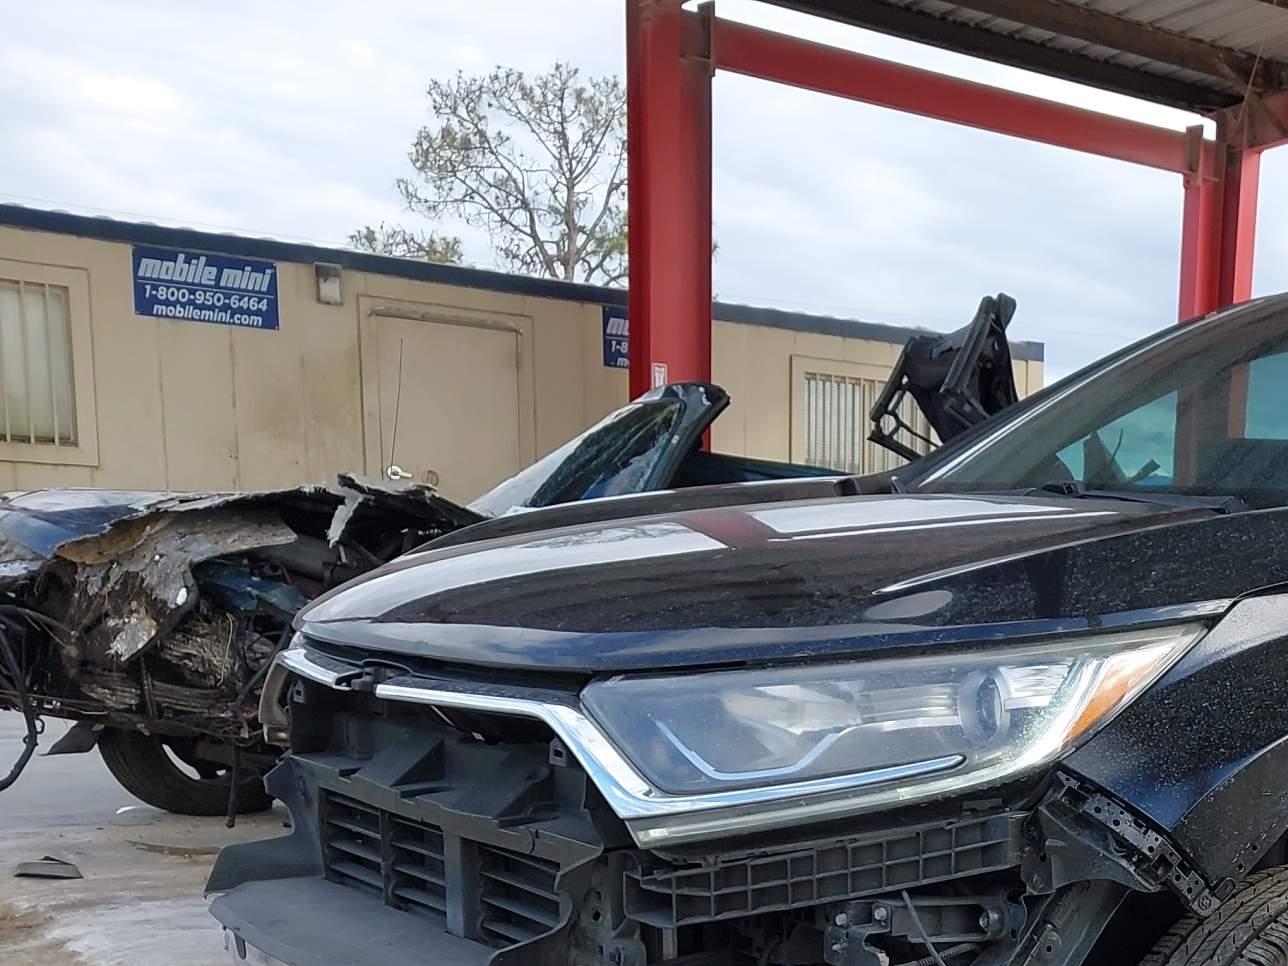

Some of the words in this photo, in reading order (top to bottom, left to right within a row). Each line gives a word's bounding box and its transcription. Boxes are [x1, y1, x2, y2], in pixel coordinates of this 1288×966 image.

[137, 253, 217, 286] mobile
[219, 265, 273, 292] mini
[144, 284, 268, 312] 1-800-950-6464
[152, 303, 263, 327] mobilemini.com
